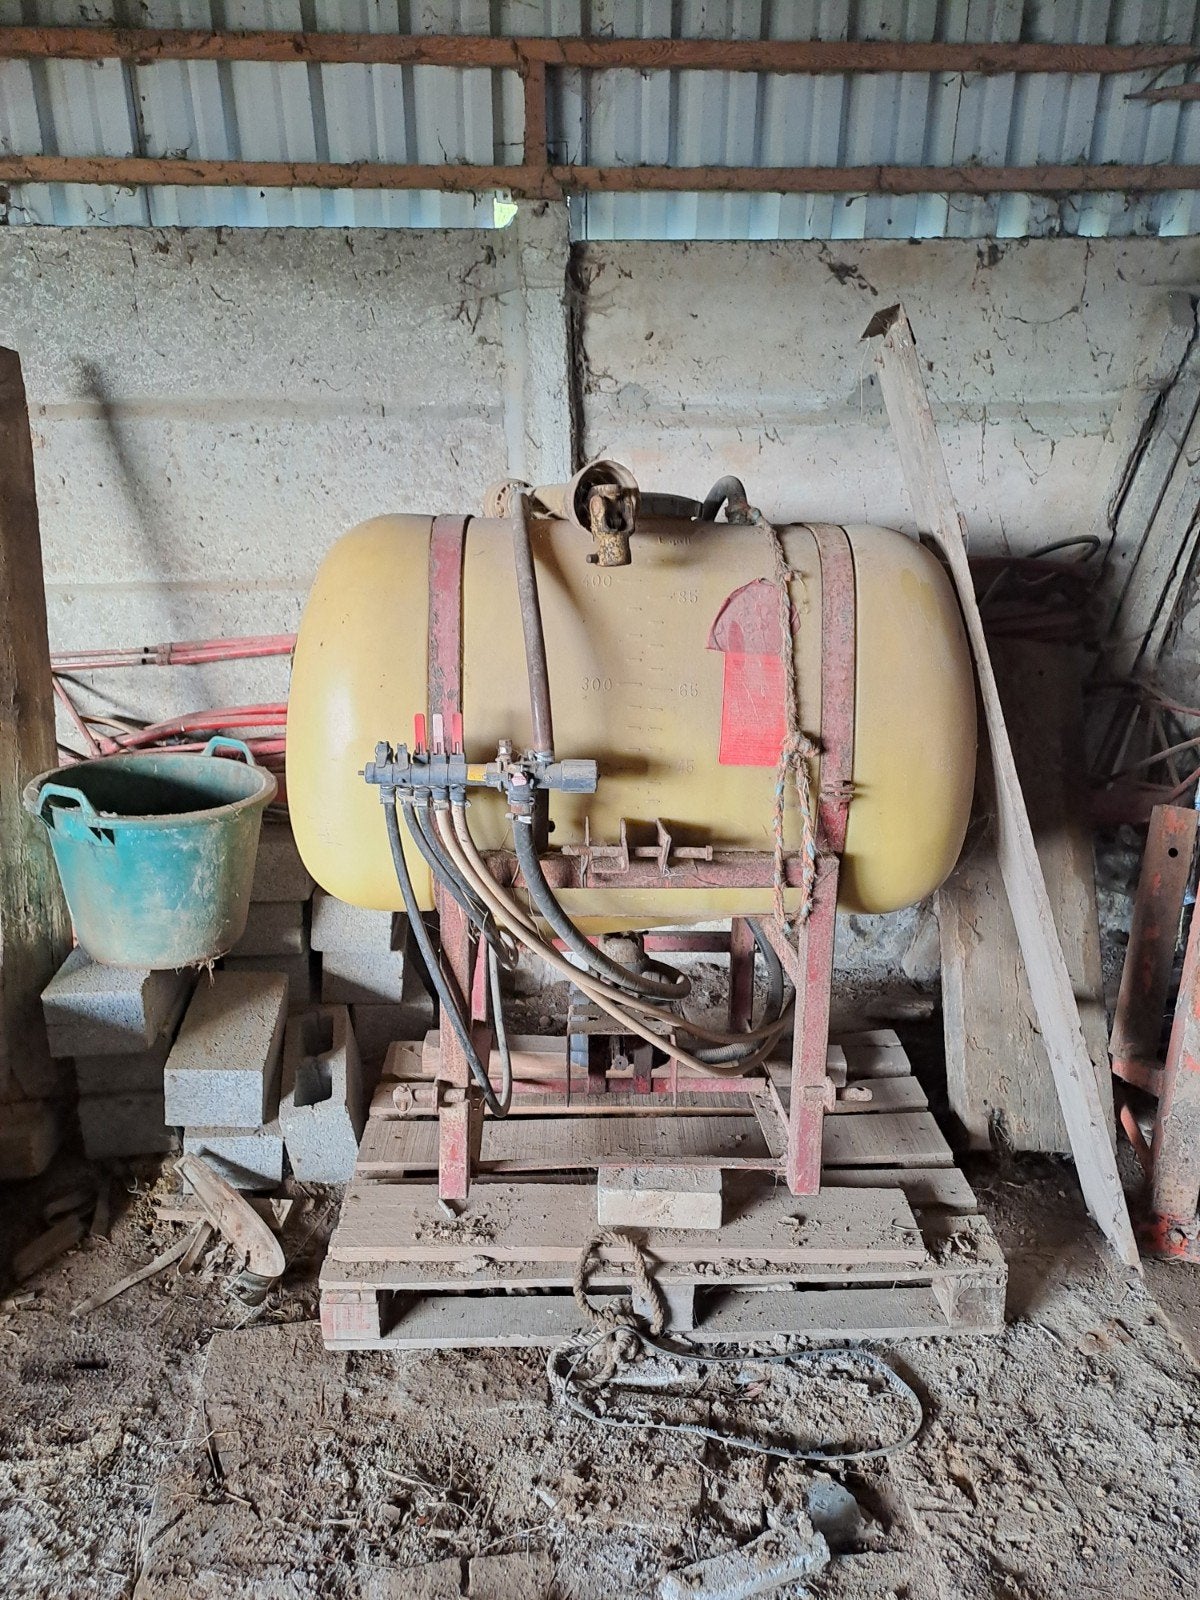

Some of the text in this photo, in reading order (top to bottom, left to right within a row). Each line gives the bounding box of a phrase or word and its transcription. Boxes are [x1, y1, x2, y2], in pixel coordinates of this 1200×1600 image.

[582, 574, 612, 588] 400
[678, 590, 698, 604] 85
[581, 677, 612, 692] 300
[679, 683, 698, 698] 65
